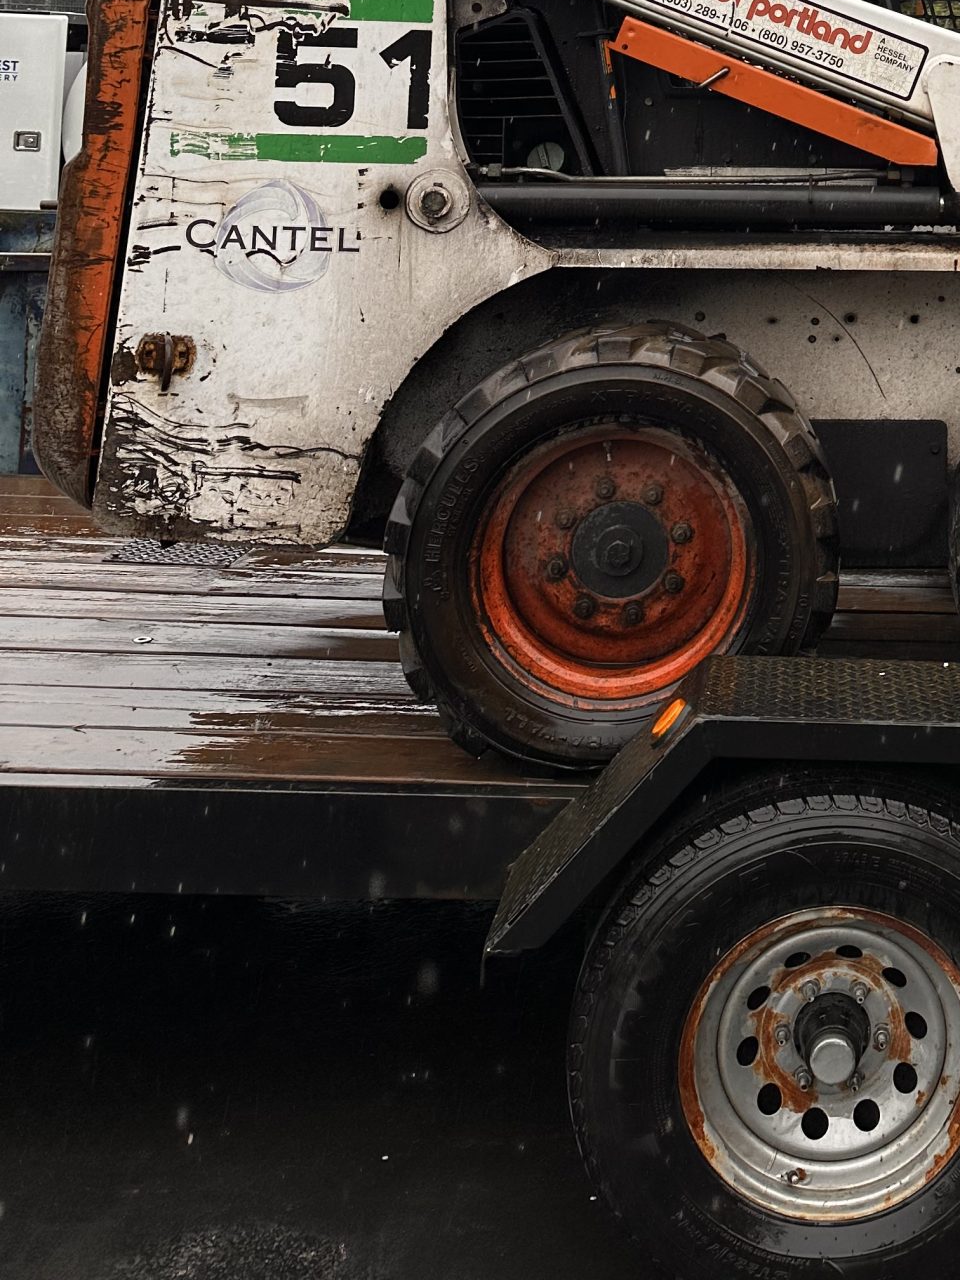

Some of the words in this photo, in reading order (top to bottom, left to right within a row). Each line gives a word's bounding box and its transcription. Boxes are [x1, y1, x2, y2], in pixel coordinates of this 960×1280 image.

[757, 27, 790, 50] (800)
[791, 40, 845, 70] 957-3750
[879, 37, 886, 45] A
[874, 52, 915, 72] COMPANY
[877, 45, 908, 62] HESSEL
[0, 60, 19, 71] ST
[273, 26, 433, 130] 51
[185, 219, 361, 253] CANTEL
